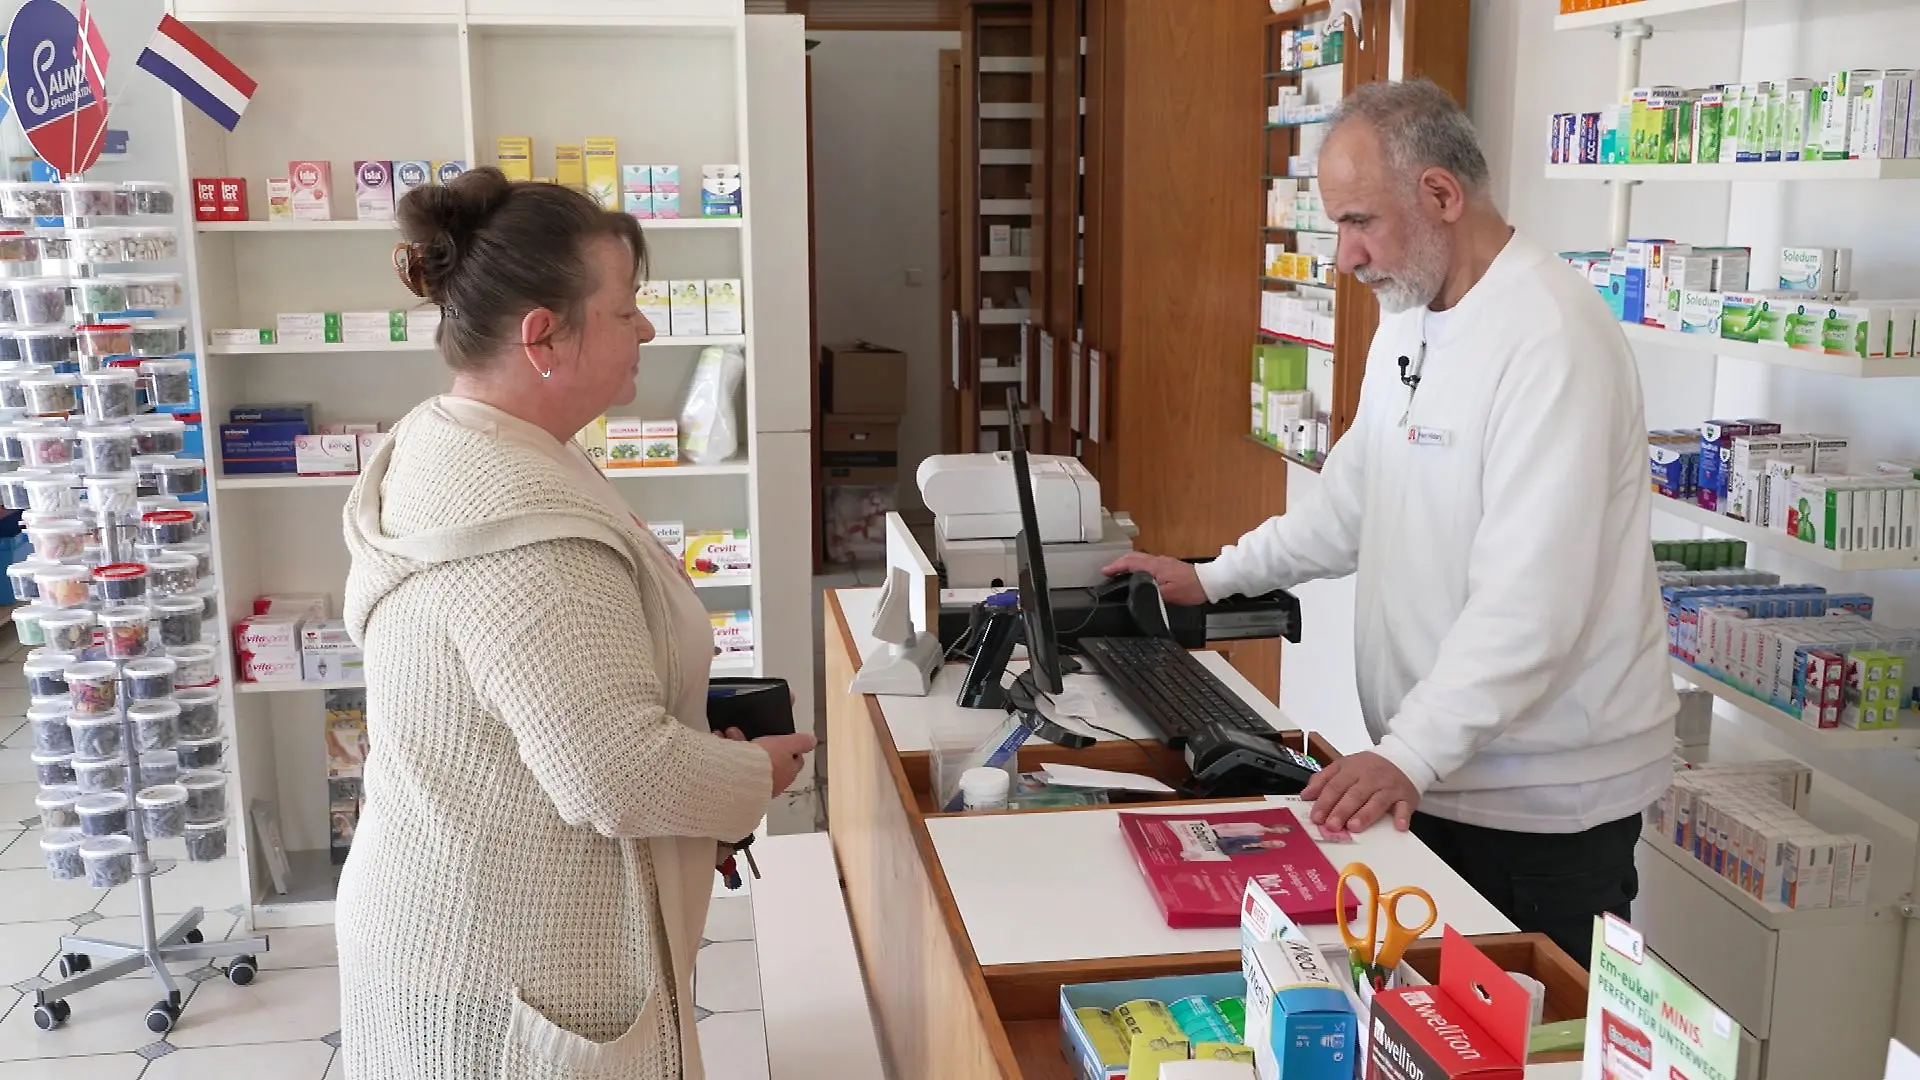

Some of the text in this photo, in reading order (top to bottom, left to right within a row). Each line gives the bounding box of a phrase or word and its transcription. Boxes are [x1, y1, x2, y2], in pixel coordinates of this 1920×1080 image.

[1783, 249, 1818, 263] Soledum
[1686, 293, 1720, 307] Soledum
[1598, 974, 1636, 1013] PERFEKT
[1637, 1006, 1657, 1033] FÜR
